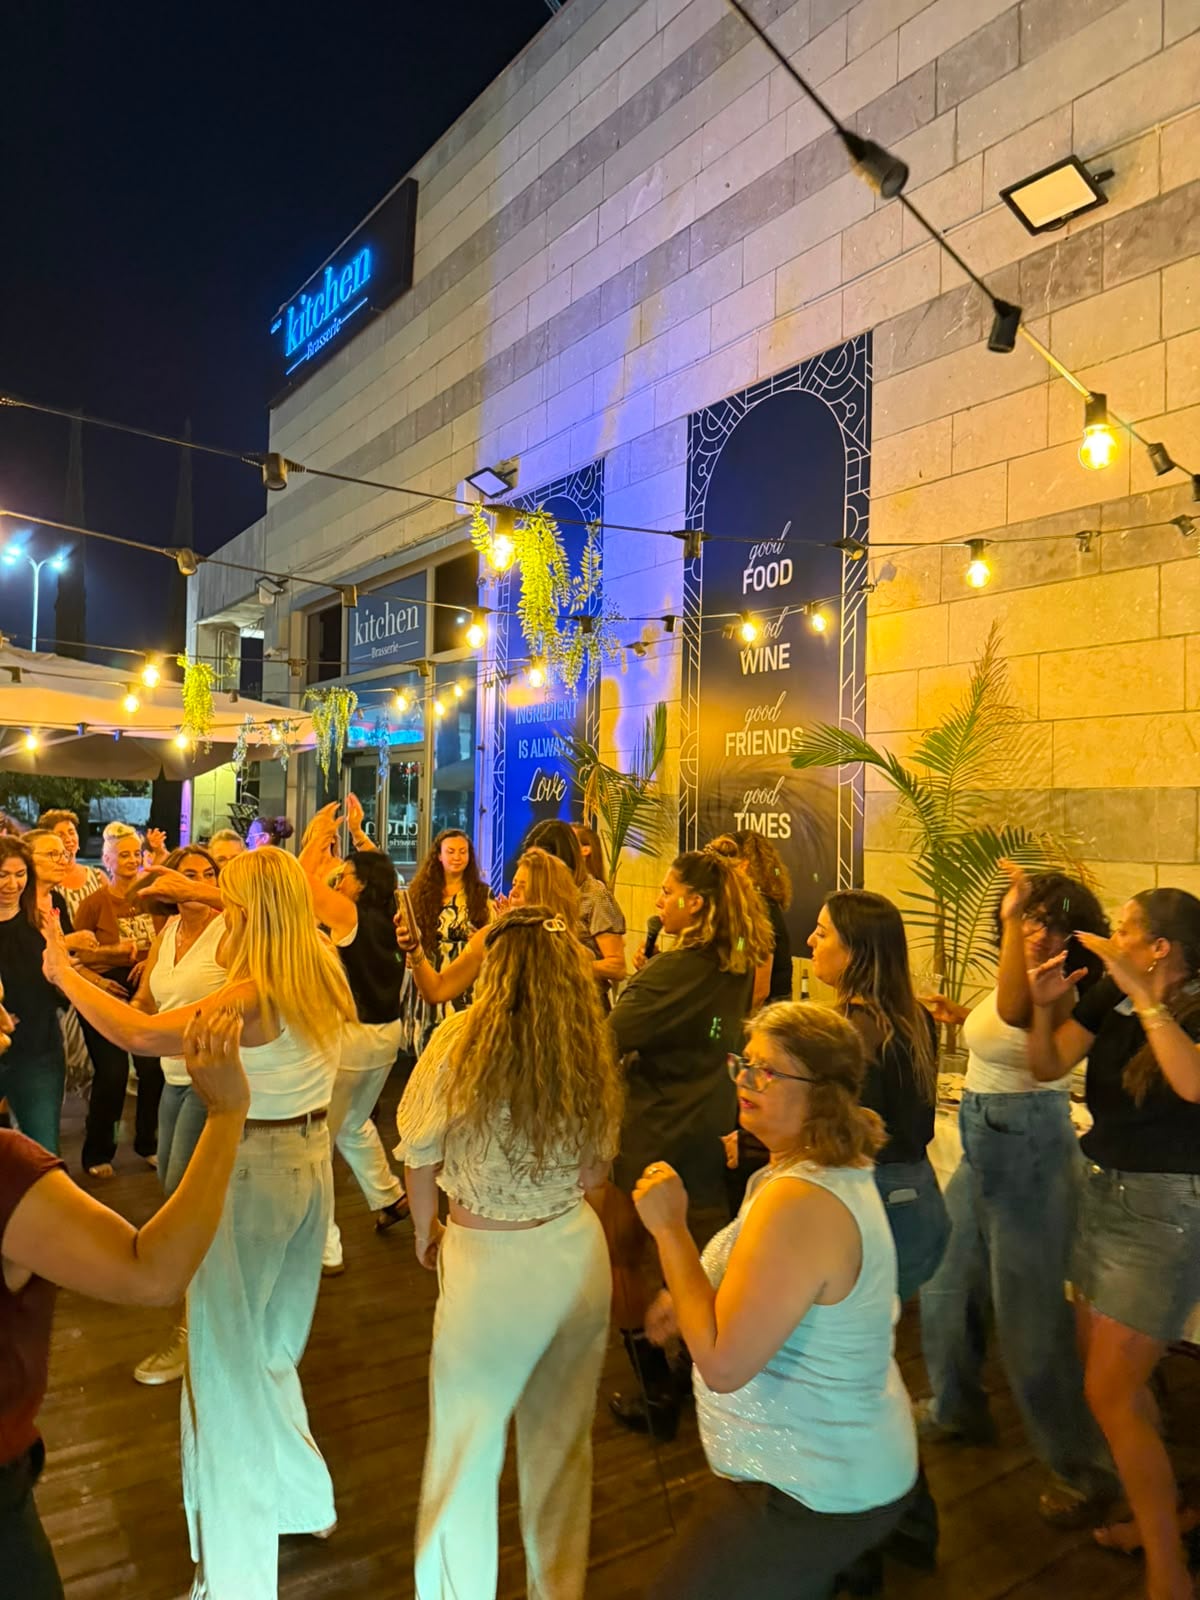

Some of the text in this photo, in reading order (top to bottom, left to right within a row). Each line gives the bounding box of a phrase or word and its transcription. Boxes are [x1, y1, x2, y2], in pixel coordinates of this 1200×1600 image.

[285, 248, 371, 357] kitchen
[306, 318, 343, 360] Brasserie
[748, 520, 792, 569] good
[743, 558, 793, 594] FOOD
[354, 601, 419, 646] kitchen
[371, 641, 399, 658] Brasserie
[740, 643, 791, 675] WINE
[515, 698, 578, 725] INGREDIENT
[744, 690, 787, 734] good
[518, 736, 574, 759] IS ALWAS
[725, 726, 804, 757] FRIENDS
[522, 767, 568, 802] Love
[743, 776, 786, 815] good
[733, 812, 791, 839] TIMES
